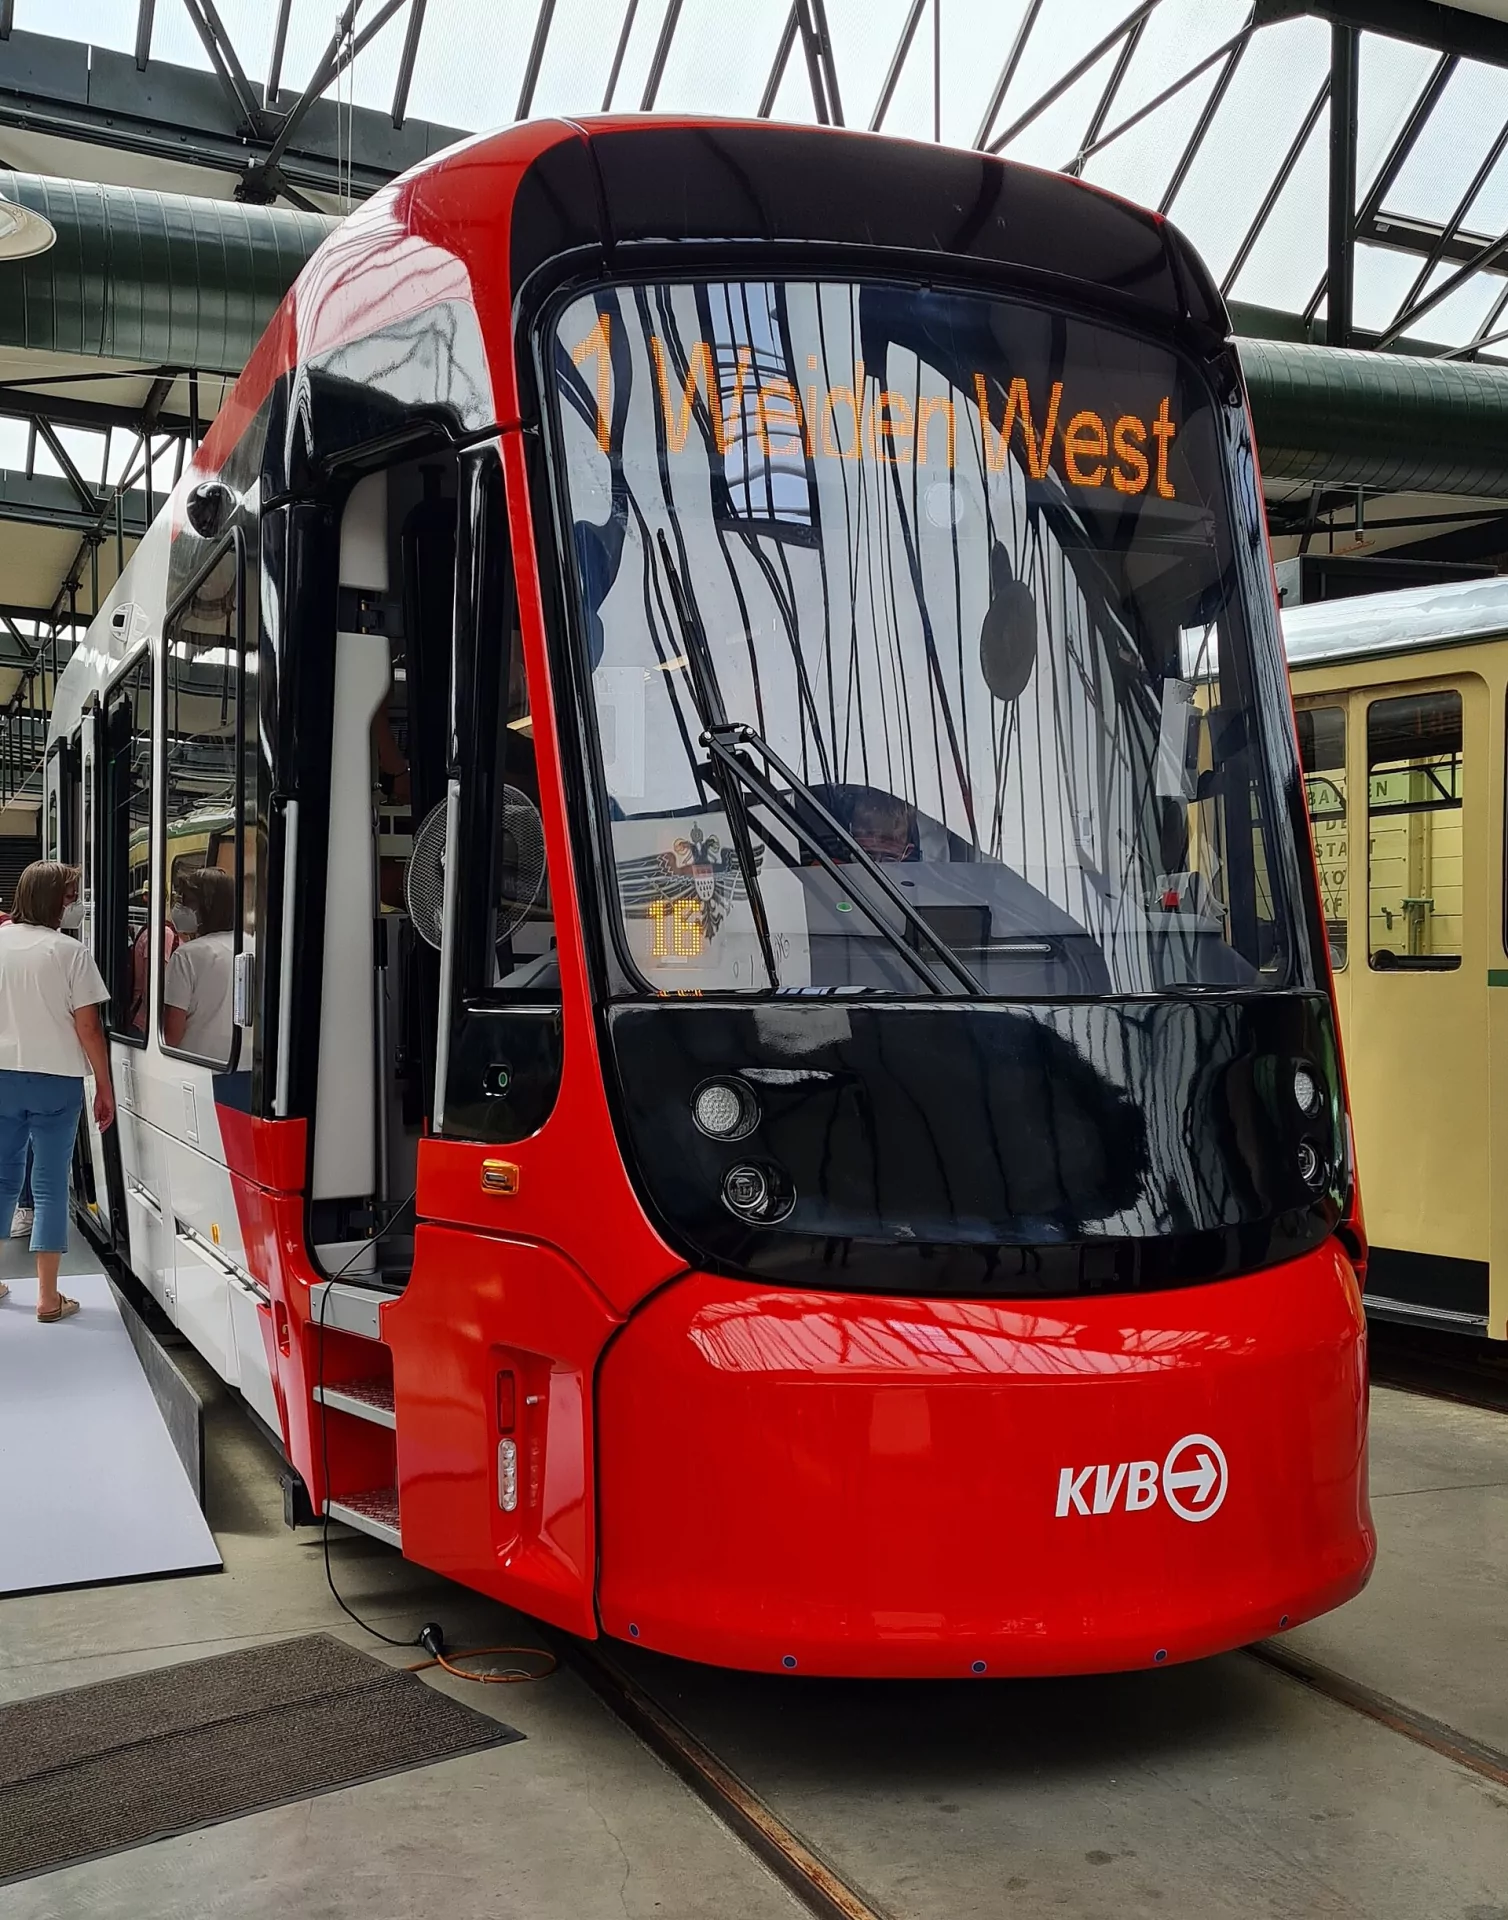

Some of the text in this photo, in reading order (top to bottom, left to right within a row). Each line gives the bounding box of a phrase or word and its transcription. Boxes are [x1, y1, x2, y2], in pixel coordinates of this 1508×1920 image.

[573, 313, 1176, 499] 1 Weiden West
[1314, 838, 1376, 858] STAT
[648, 899, 701, 957] 16
[1055, 1460, 1159, 1518] KVB
